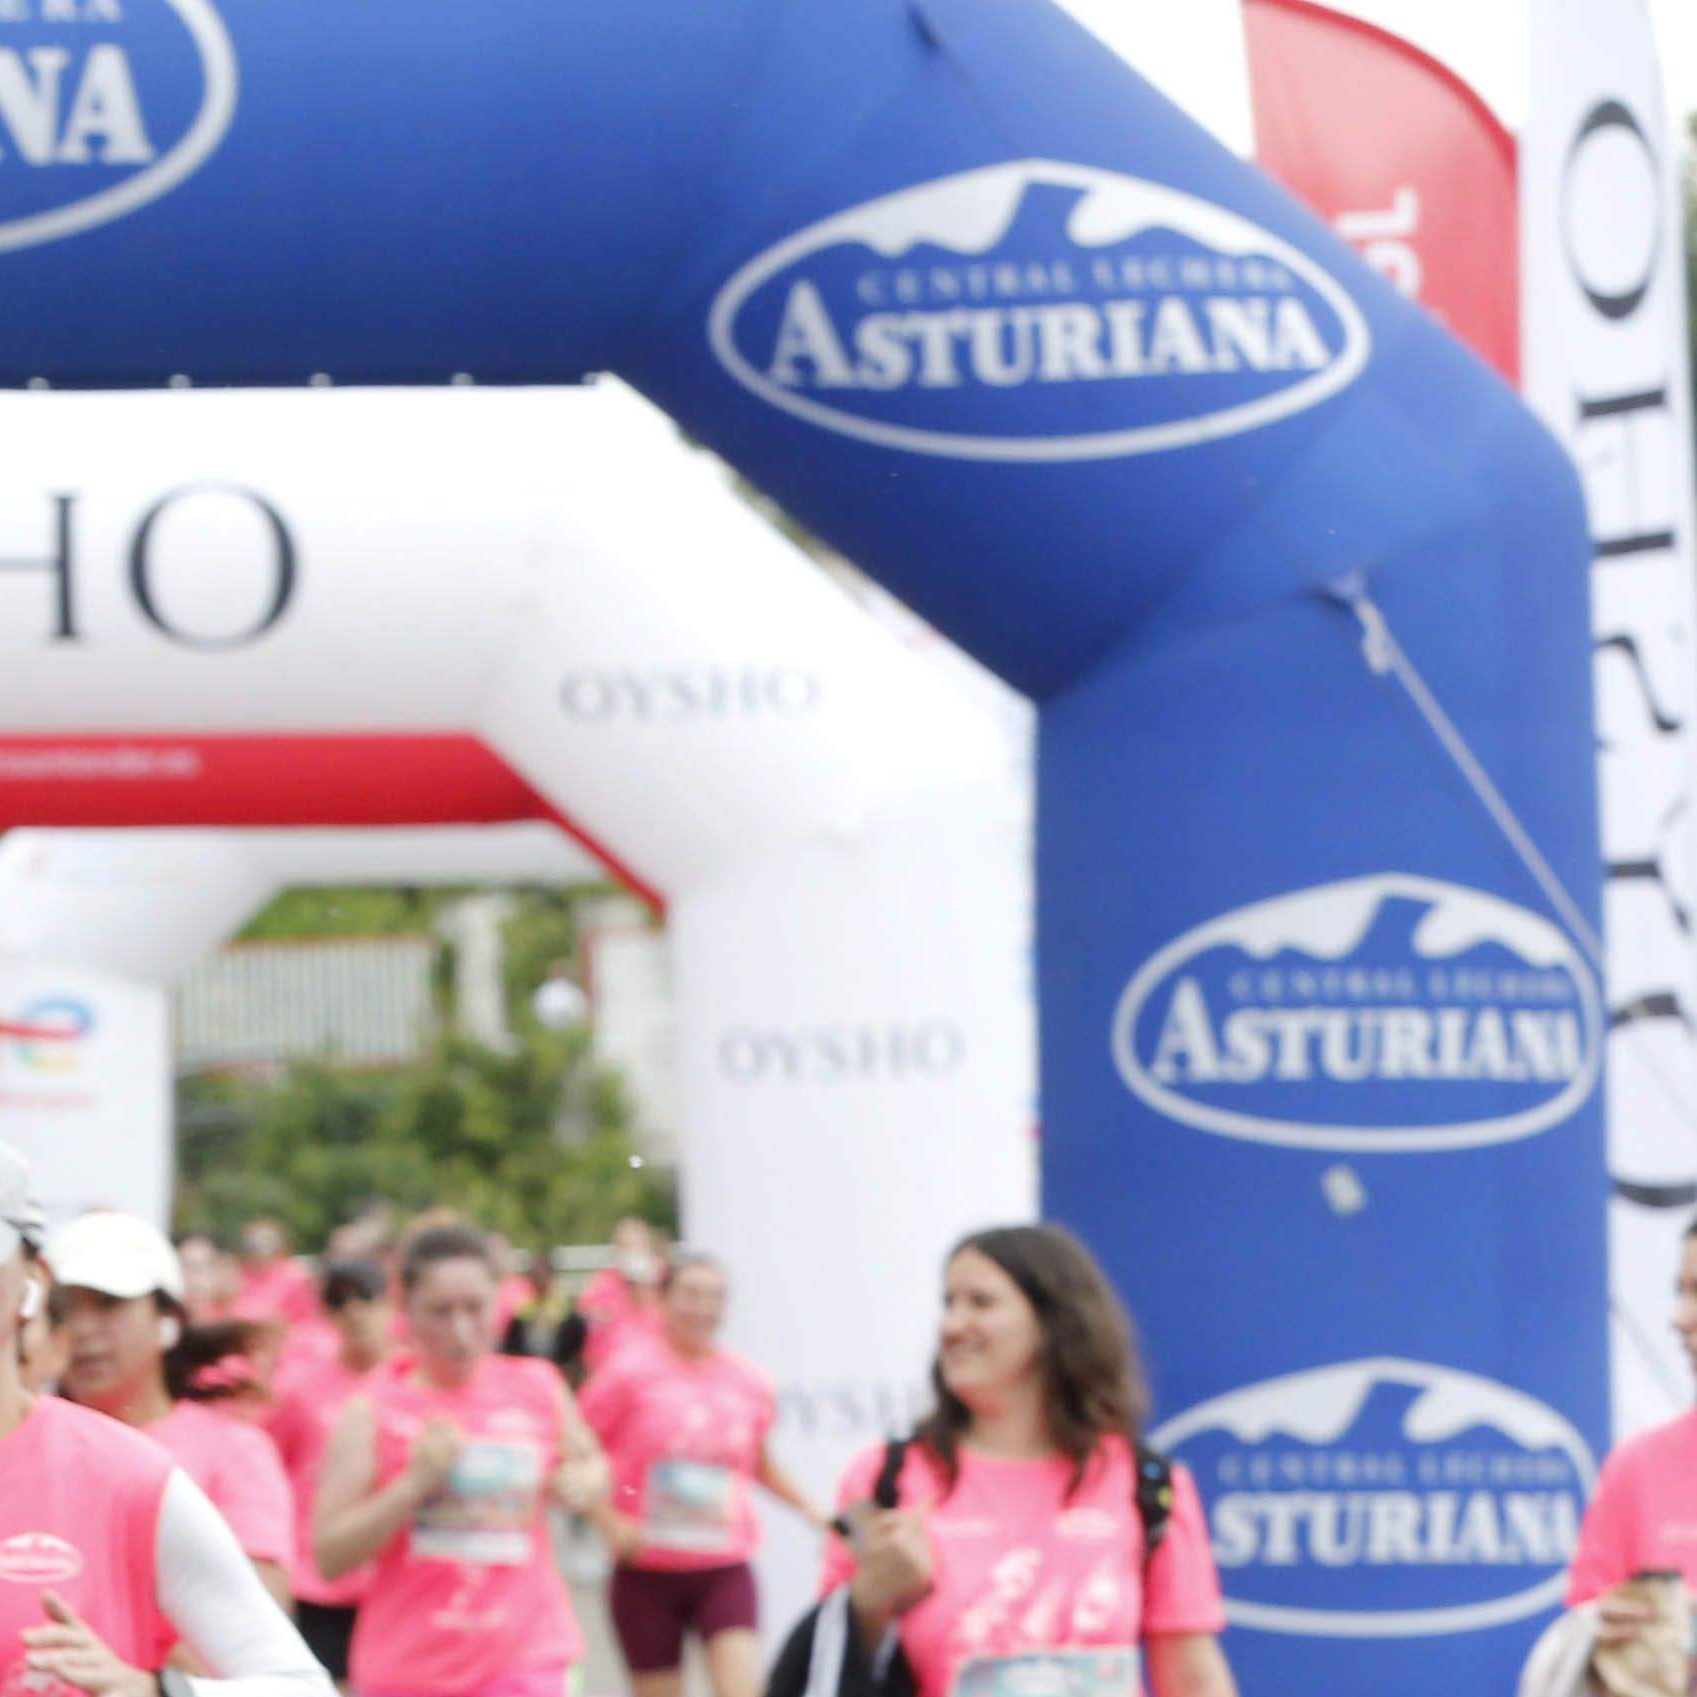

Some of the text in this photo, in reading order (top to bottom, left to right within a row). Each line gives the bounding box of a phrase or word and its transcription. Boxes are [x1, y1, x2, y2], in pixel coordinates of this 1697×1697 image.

[769, 278, 1333, 391] ASTURIANA
[559, 667, 823, 725] OYSHO
[717, 1020, 967, 1084] OYSHO
